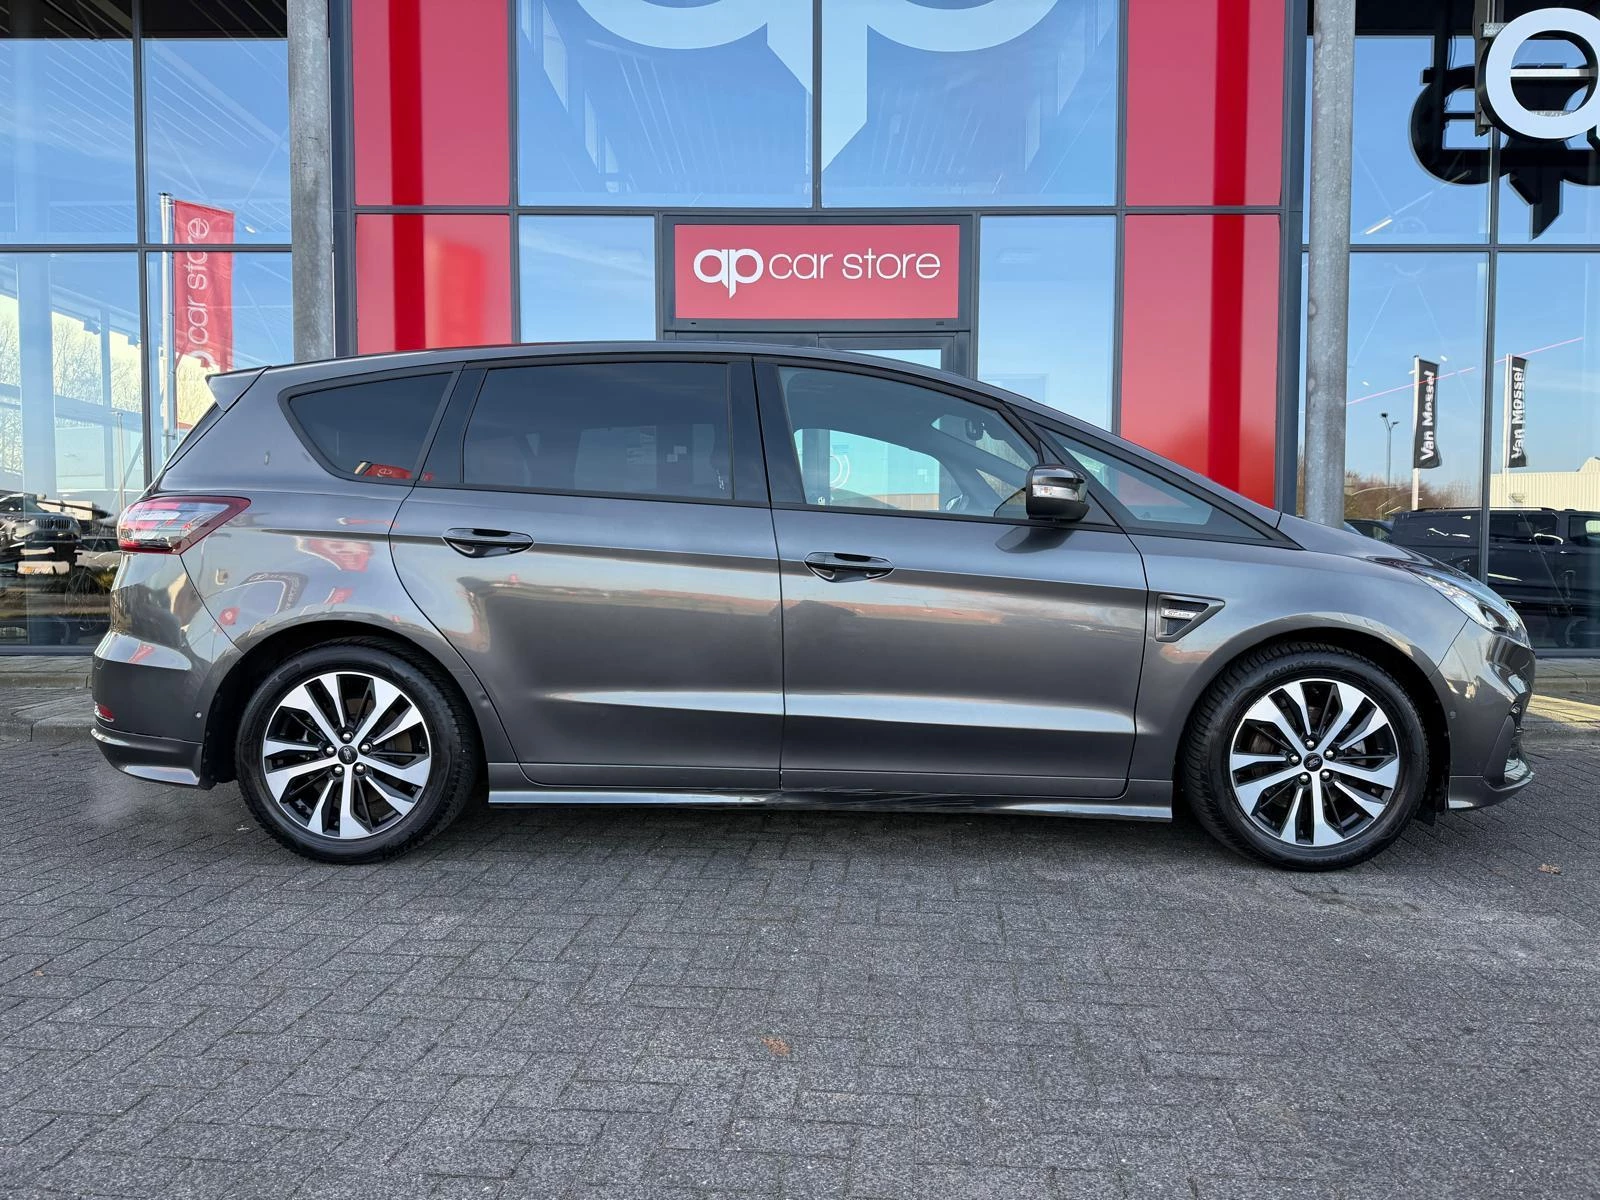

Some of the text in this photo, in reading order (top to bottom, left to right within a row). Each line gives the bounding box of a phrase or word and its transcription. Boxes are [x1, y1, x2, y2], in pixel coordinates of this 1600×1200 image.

[693, 248, 941, 299] ap car store
[187, 295, 209, 345] car
[1420, 370, 1435, 460] Van Mossel
[1511, 366, 1526, 459] Van Mossel
